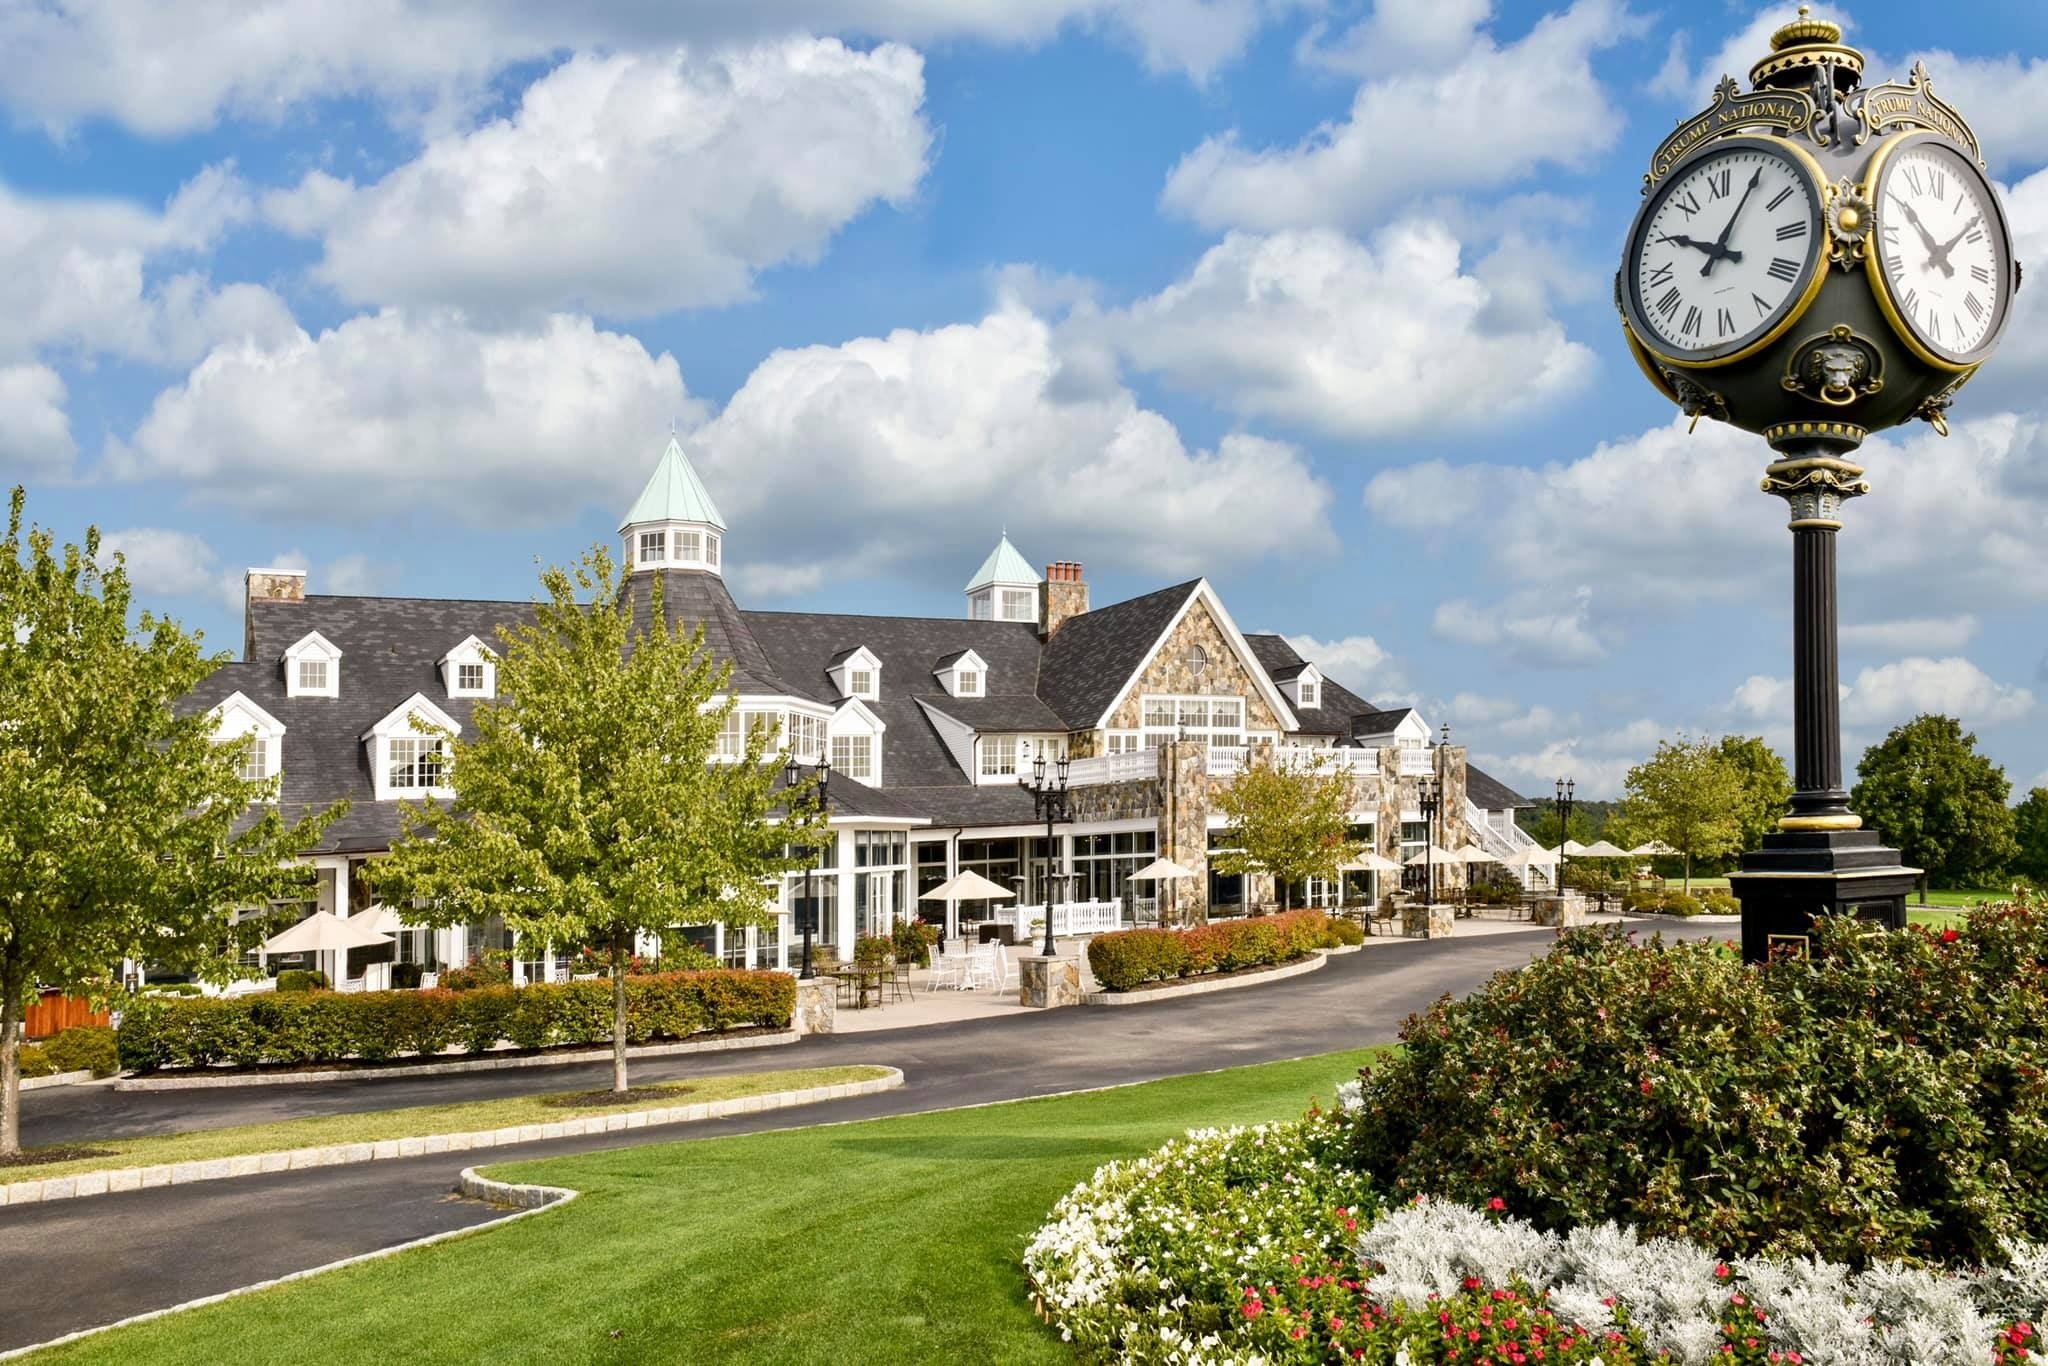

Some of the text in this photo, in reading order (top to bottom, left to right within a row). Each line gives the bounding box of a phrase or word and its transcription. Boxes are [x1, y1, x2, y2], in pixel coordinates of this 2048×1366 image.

[1873, 97, 1912, 115] TRUMP
[1662, 102, 1795, 163] TRUMP NATIONAL
[1708, 168, 1731, 203] XII
[1928, 166, 1944, 200] XII
[1675, 191, 1701, 222] XI
[1765, 186, 1794, 212] II
[1776, 221, 1807, 241] III
[1650, 262, 1673, 288] IX
[1767, 257, 1800, 283] IIII
[1751, 292, 1772, 317] V
